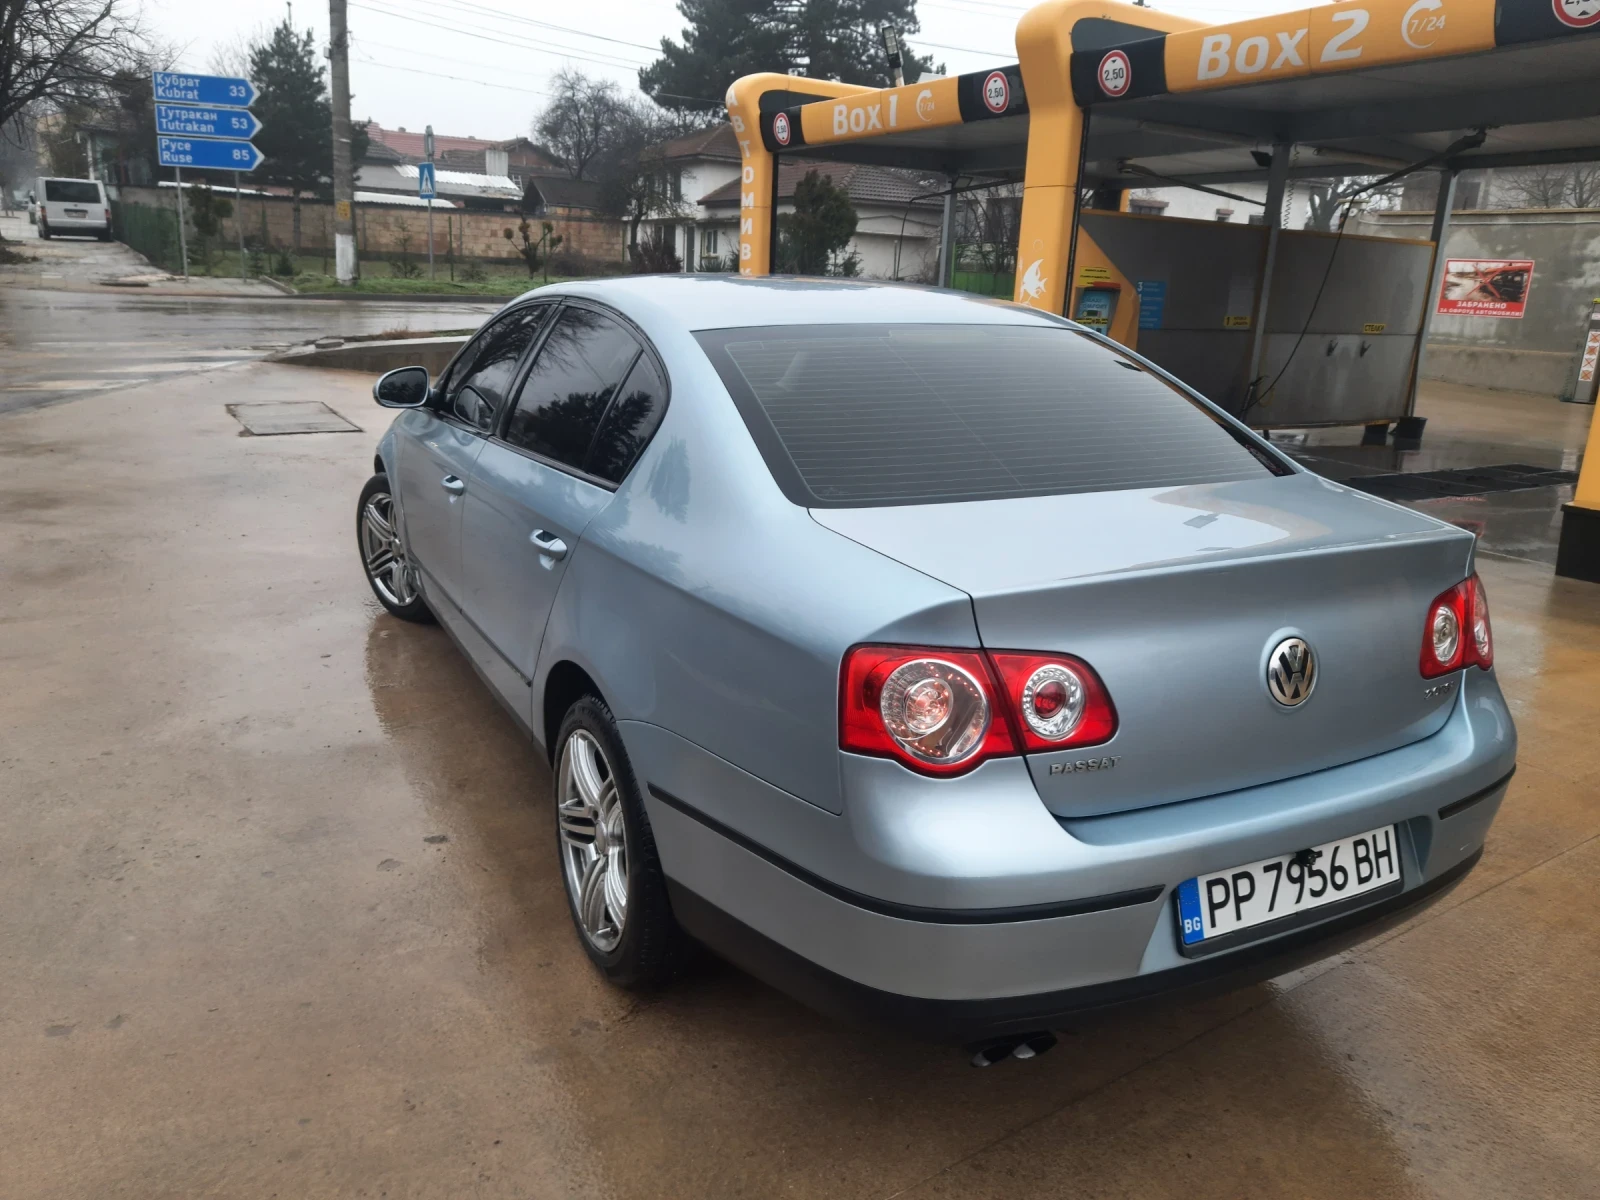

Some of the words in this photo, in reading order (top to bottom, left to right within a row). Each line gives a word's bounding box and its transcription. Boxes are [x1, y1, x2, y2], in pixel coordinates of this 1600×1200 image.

[1409, 15, 1446, 34] 7/24
[1197, 28, 1308, 81] Box
[1320, 9, 1370, 62] 2
[156, 73, 200, 88] Кубрат
[157, 86, 199, 100] Kubrat
[229, 85, 246, 97] 33
[159, 106, 218, 121] Тутракан
[832, 103, 882, 136] Box
[889, 94, 898, 127] 1
[160, 119, 215, 133] Tutrakan
[231, 117, 248, 129] 53
[161, 139, 191, 152] Русе
[163, 151, 193, 163] Ruse
[232, 149, 250, 161] 85
[1456, 301, 1507, 309] ЗАБРАНЕНО
[1049, 755, 1122, 776] PASSAT
[1206, 870, 1256, 929] PP
[1263, 845, 1349, 913] 7956
[1352, 830, 1394, 886] BH
[1184, 916, 1201, 934] BG
